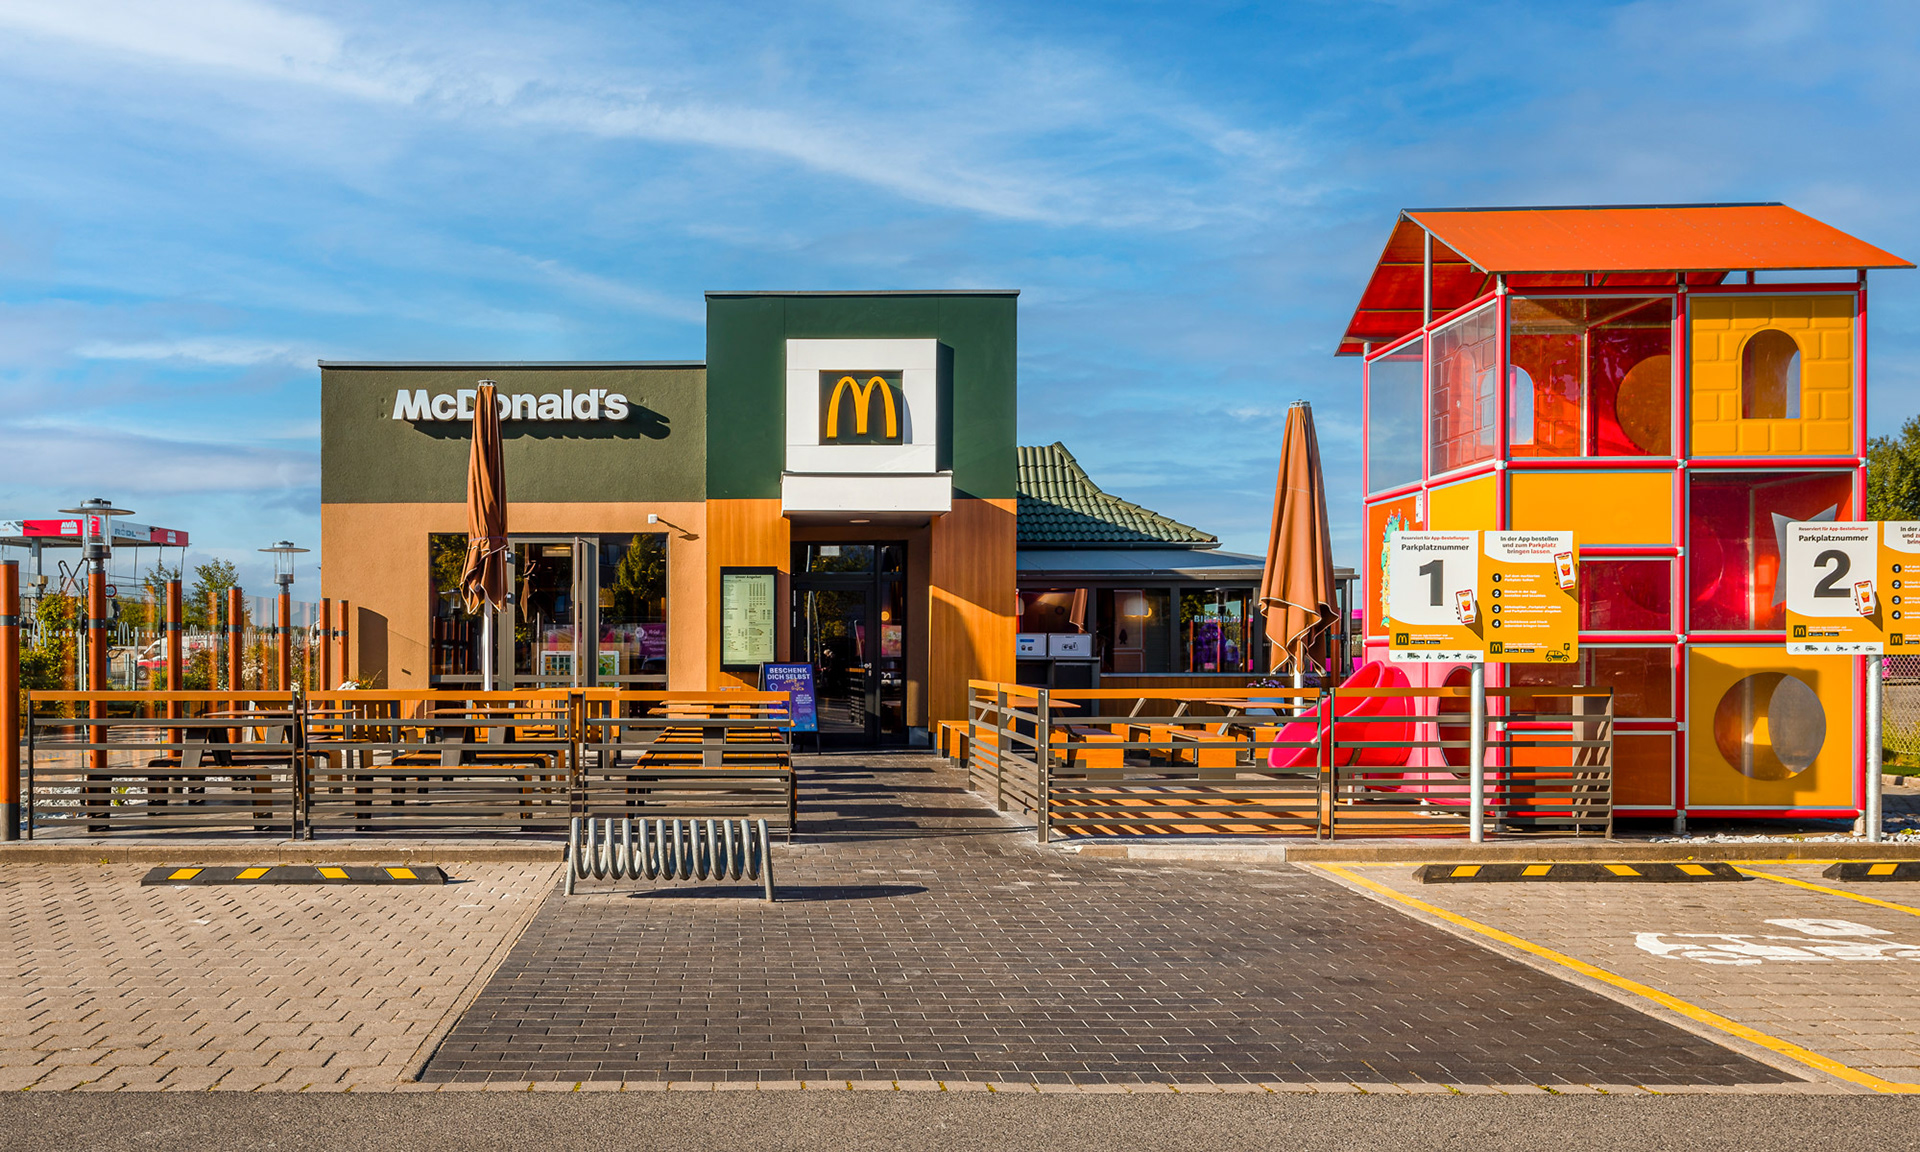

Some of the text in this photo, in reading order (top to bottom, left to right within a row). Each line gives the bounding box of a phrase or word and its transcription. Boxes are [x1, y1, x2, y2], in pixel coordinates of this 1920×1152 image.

[1401, 544, 1470, 553] Parkplatznummer
[1799, 535, 1868, 543] Parkplatznummer
[1419, 559, 1444, 607] 1
[1814, 549, 1851, 598] 2
